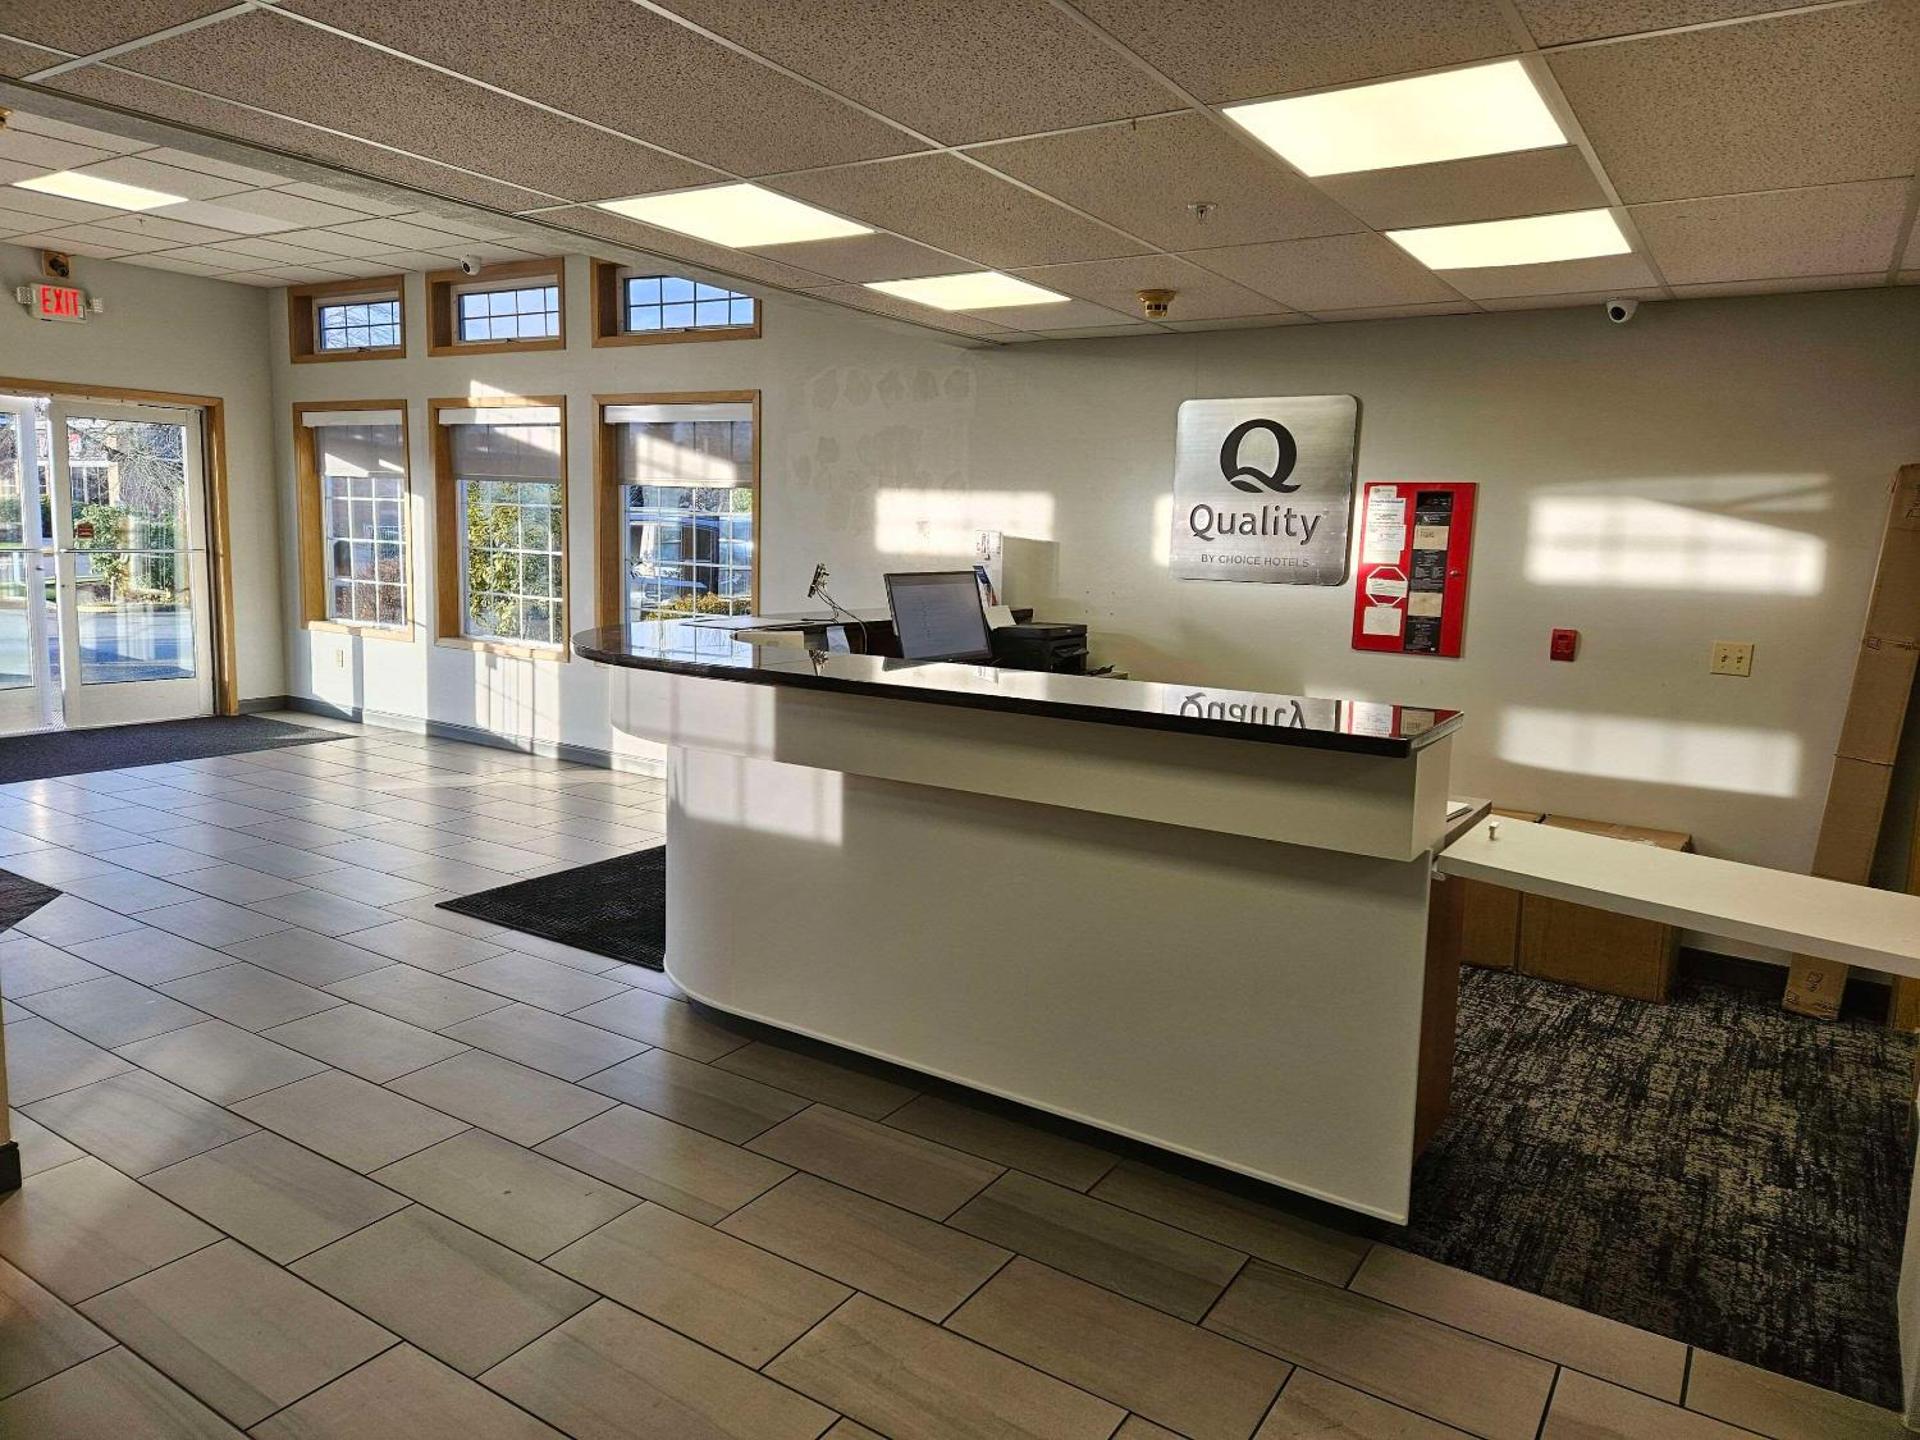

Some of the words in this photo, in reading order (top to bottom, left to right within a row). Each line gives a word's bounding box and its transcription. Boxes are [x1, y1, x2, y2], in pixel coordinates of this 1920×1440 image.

[41, 286, 79, 318] EXIT
[1220, 418, 1302, 494] Q
[1189, 503, 1322, 546] Quality
[1201, 553, 1215, 563] BY
[1218, 554, 1261, 566] CHOICE
[1264, 556, 1310, 568] HOTELS
